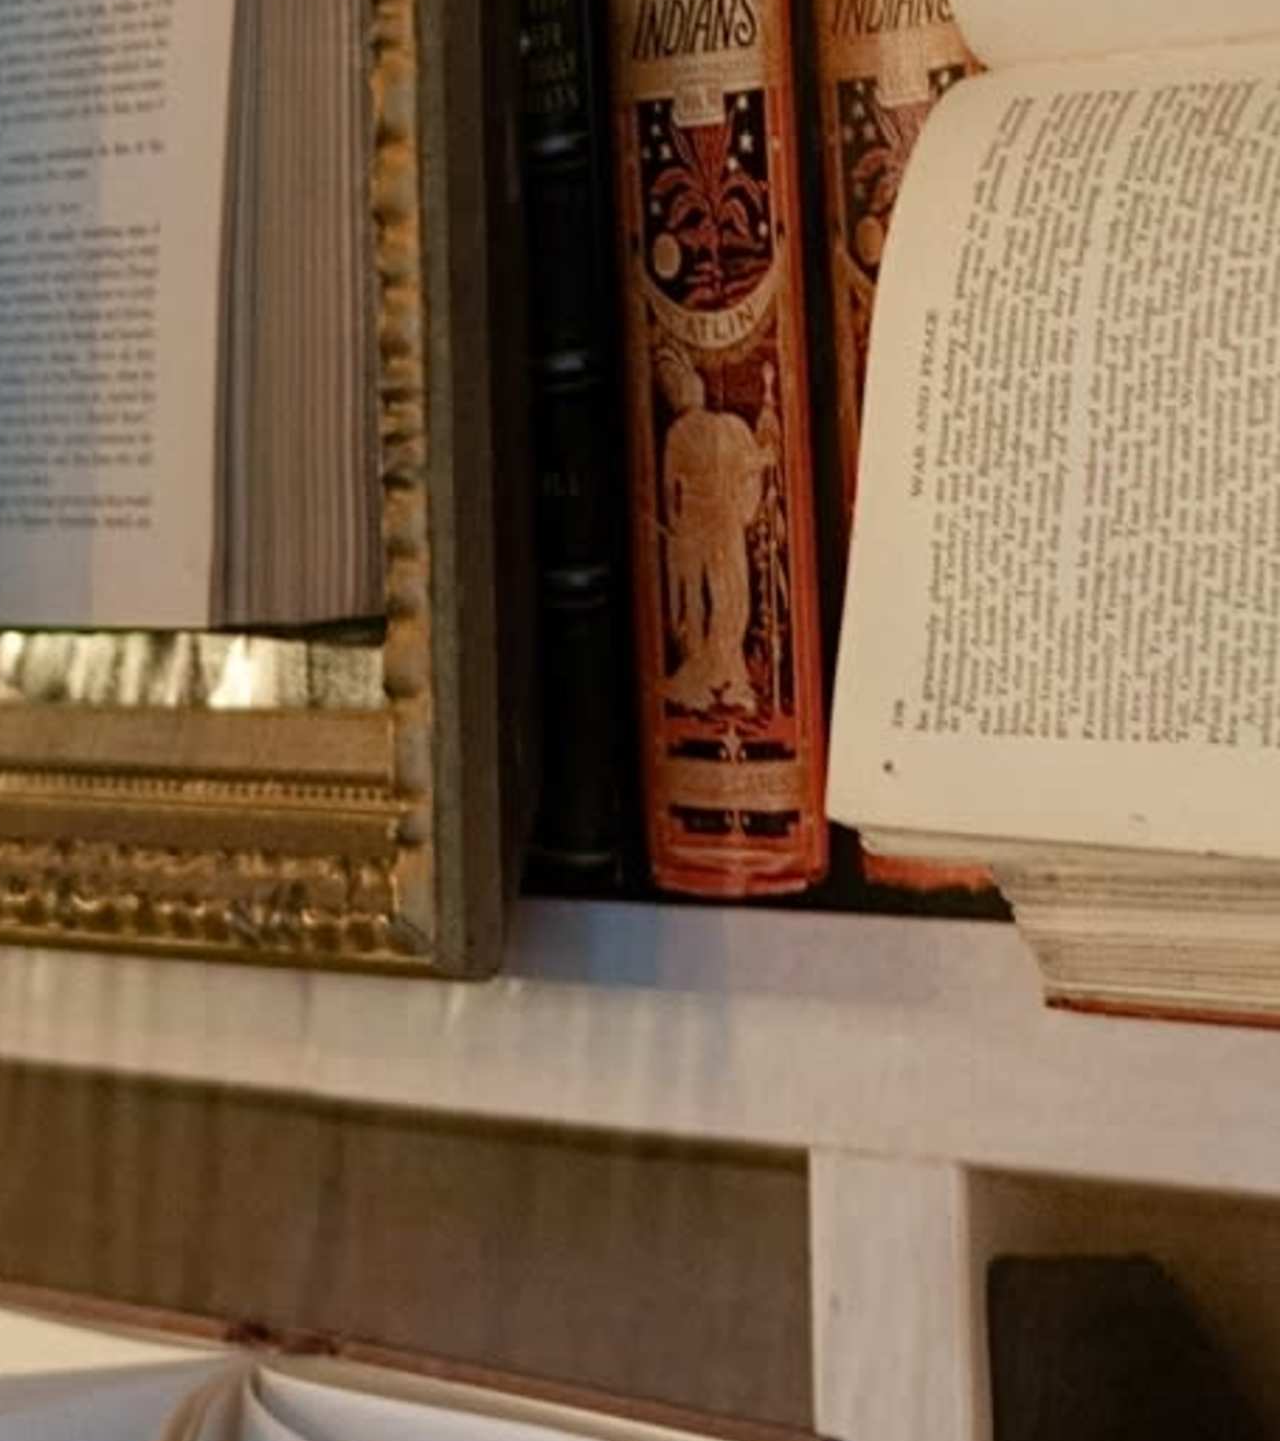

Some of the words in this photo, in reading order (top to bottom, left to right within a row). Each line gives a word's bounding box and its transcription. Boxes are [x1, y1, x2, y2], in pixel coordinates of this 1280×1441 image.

[921, 310, 938, 378] PEACE
[917, 385, 930, 434] AND
[912, 445, 925, 497] WAR
